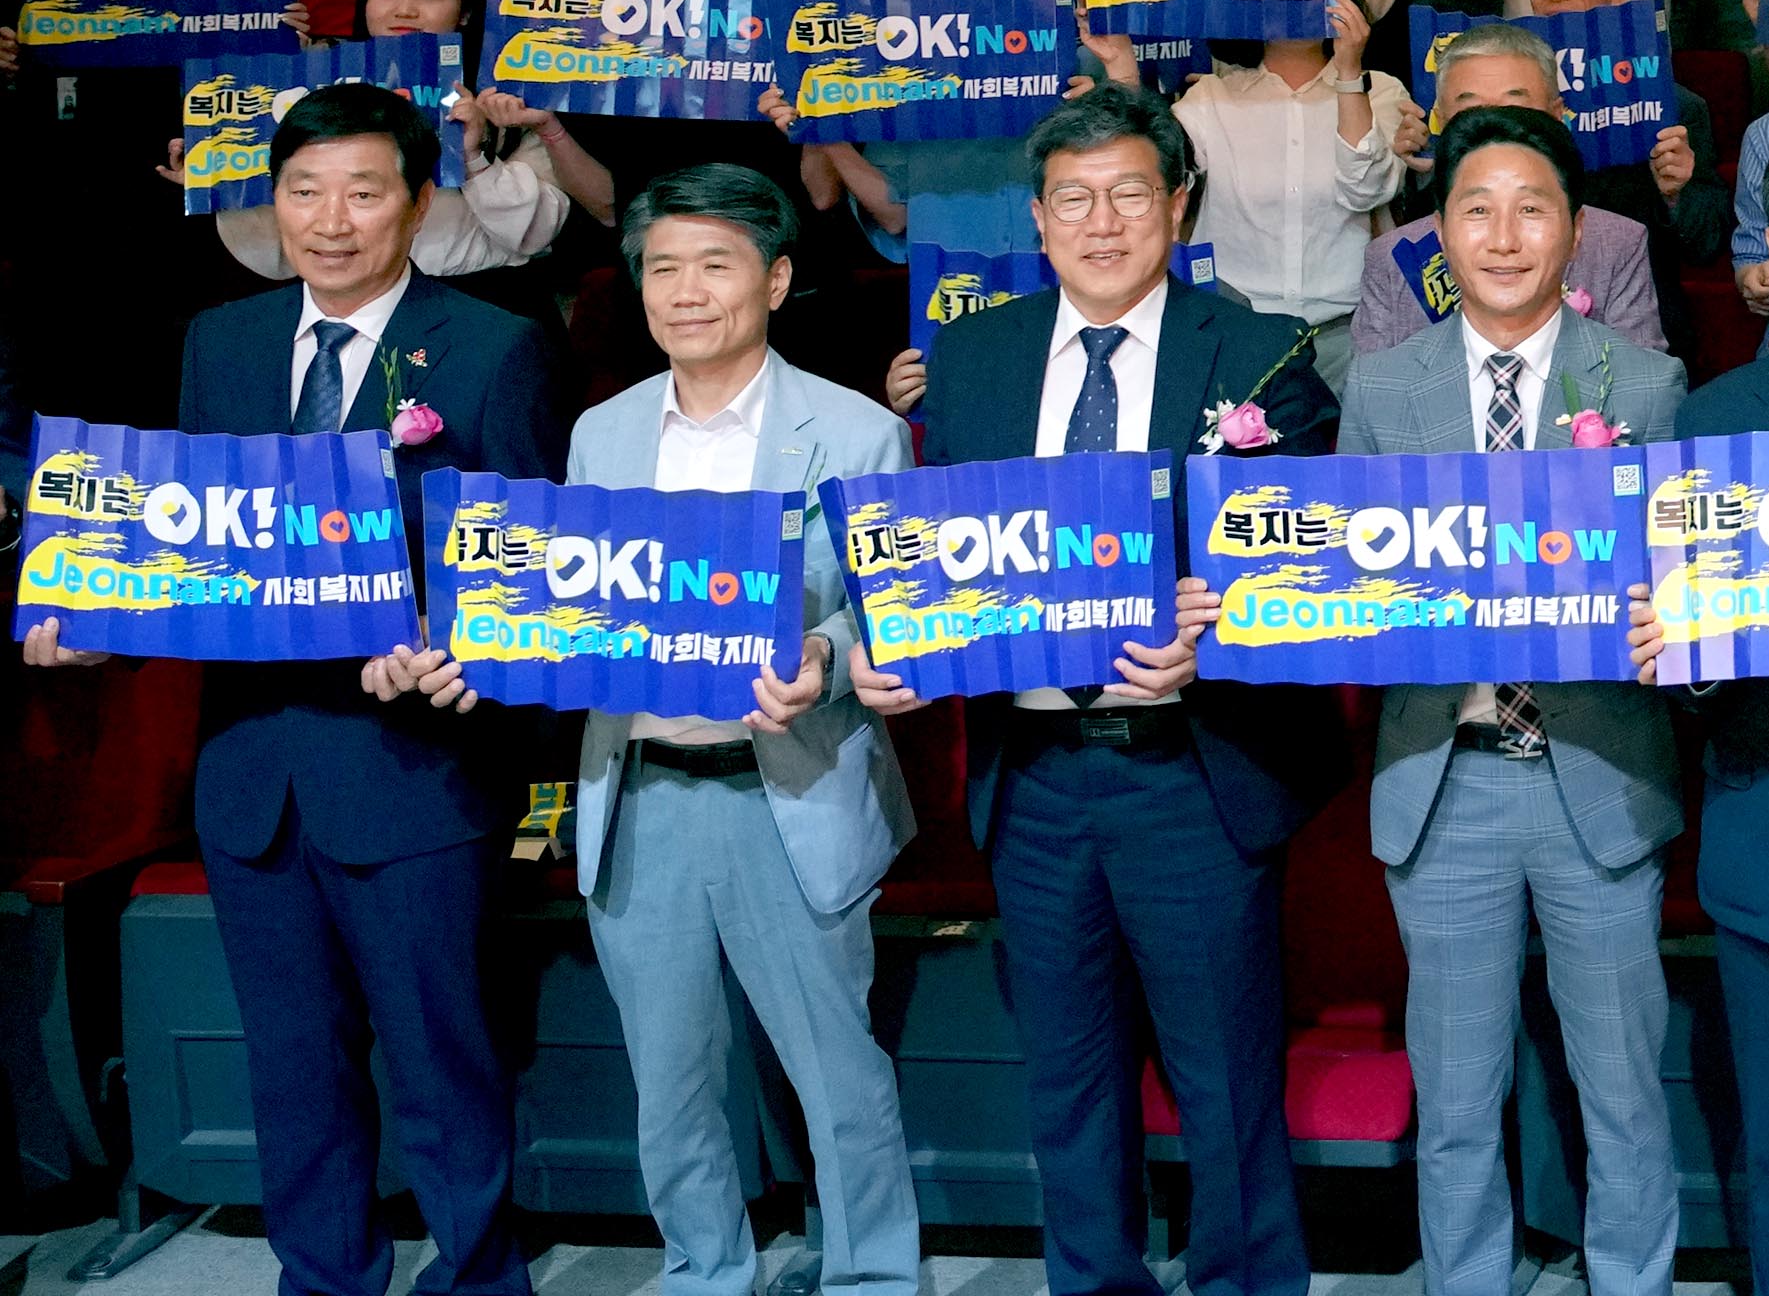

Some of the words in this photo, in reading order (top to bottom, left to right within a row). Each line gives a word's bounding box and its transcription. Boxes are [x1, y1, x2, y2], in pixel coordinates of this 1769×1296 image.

[20, 16, 176, 34] Jeonnam
[183, 13, 287, 32] 사회복지사
[795, 19, 863, 49] 복지는
[872, 14, 970, 60] OK!
[976, 25, 1056, 54] Now
[507, 45, 683, 82] Jeonnam
[802, 80, 961, 103] Jeonnam
[964, 75, 1059, 99] 사회복지사
[38, 470, 132, 517] 복지는
[141, 482, 276, 548] OK!
[285, 506, 401, 545] Now
[1655, 492, 1743, 533] 복지는
[936, 511, 1049, 581] OK!
[1056, 525, 1152, 568] Now
[1224, 512, 1327, 548] 복지는
[1344, 505, 1487, 570] OK!
[1497, 521, 1617, 564] Now
[29, 554, 253, 606] Jeonnam
[263, 572, 404, 605] 사회복지사
[544, 536, 663, 602] OK!
[670, 560, 779, 604] Now
[1046, 597, 1155, 632] 사회복지사
[1229, 595, 1468, 629] Jeonnam
[1476, 595, 1620, 627] 사회복지사
[651, 633, 776, 668] 사회복지사
